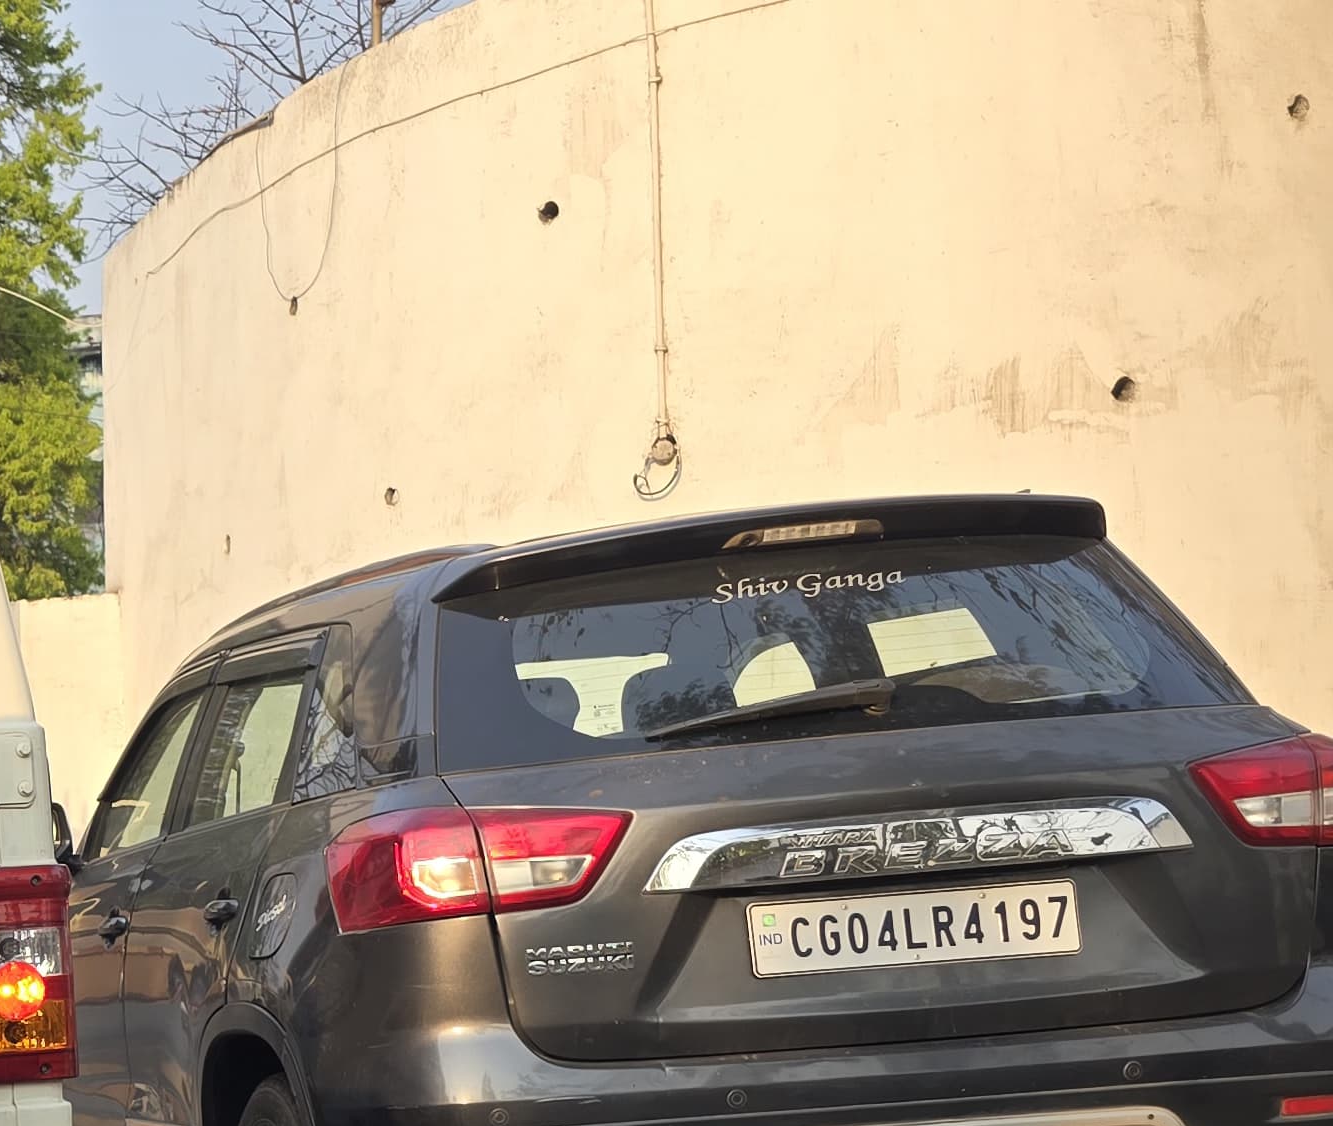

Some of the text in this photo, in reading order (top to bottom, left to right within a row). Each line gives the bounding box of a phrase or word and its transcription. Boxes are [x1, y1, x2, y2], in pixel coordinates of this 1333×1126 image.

[712, 570, 906, 604] Shiv Ganga
[780, 828, 1076, 878] BREZZA
[758, 895, 1068, 958] IND CG04LR4197
[528, 954, 633, 975] SUZUKI
